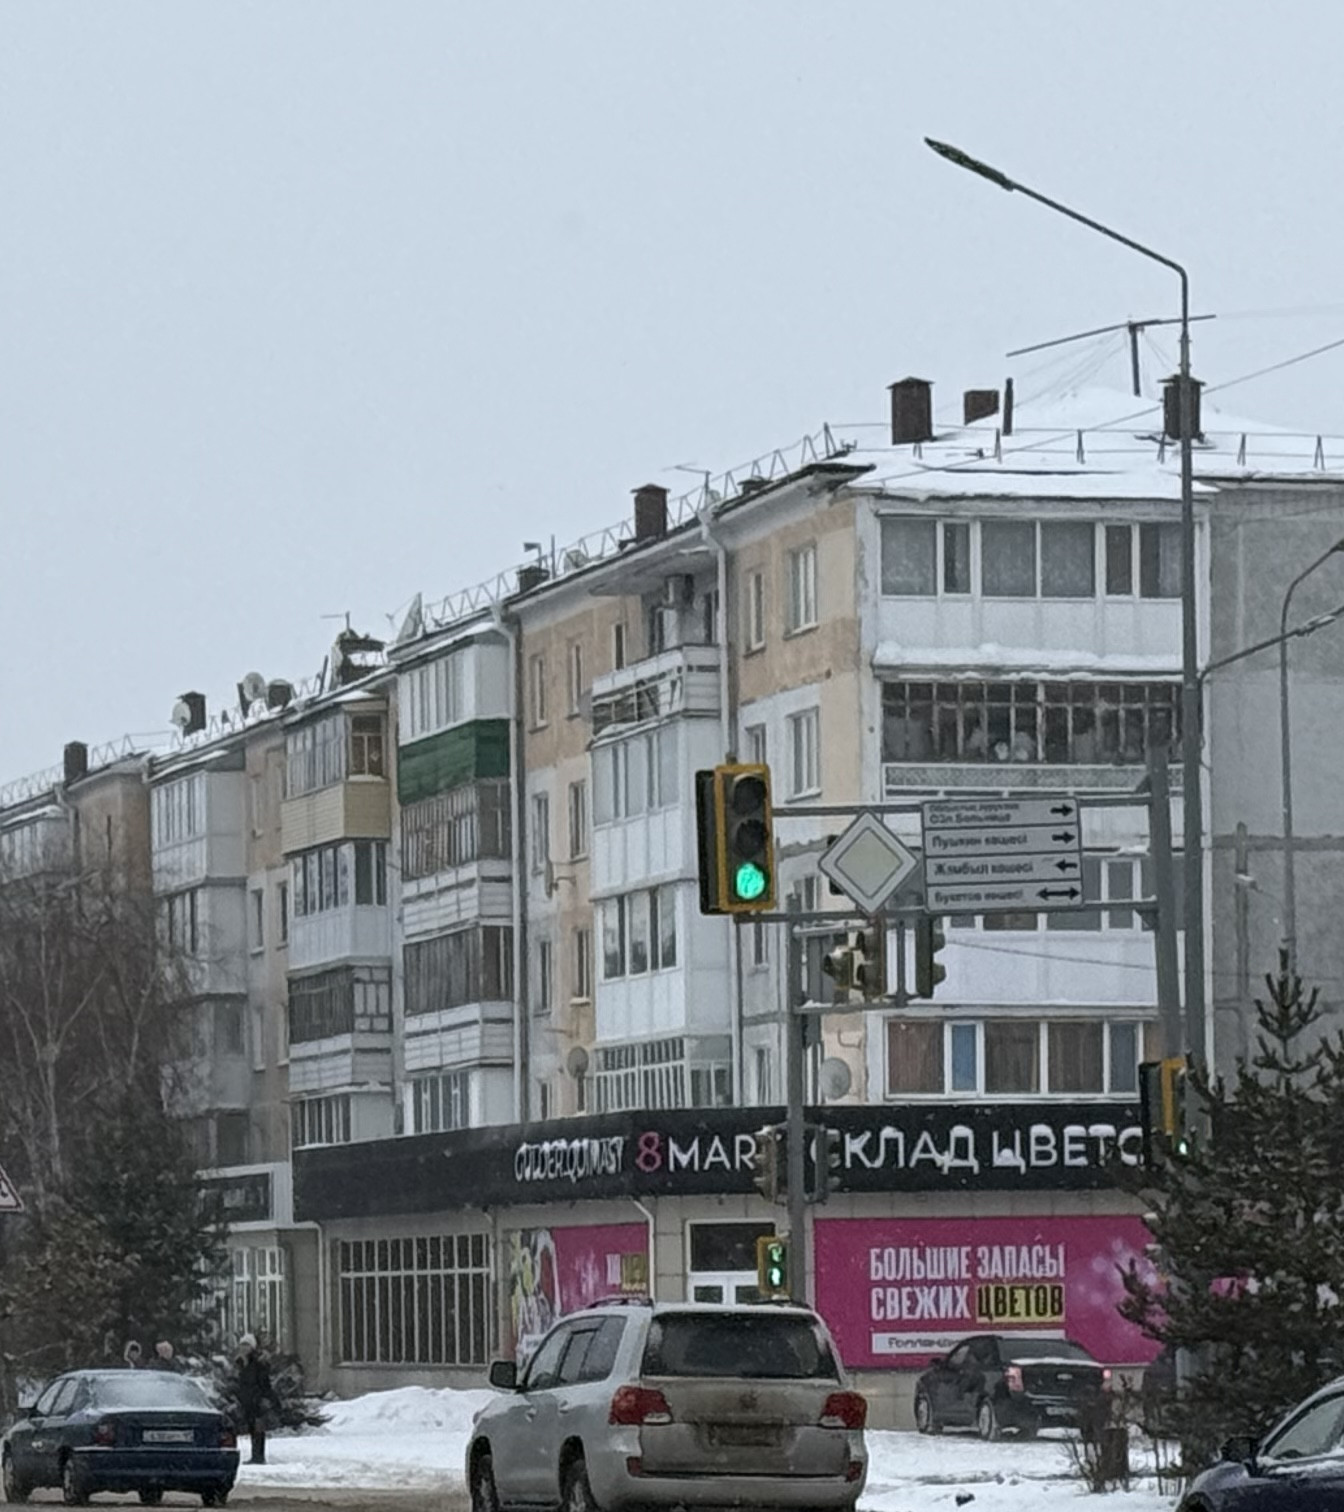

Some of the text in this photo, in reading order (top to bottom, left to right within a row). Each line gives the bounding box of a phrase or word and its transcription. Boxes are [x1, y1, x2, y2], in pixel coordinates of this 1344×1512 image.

[992, 1123, 1144, 1176] ЦВЕТО
[869, 1244, 1065, 1281] БОЛЬШИЕ ЗАПАСЫ
[871, 1284, 1064, 1321] СВЕЖИХ ЦВЕТОВ
